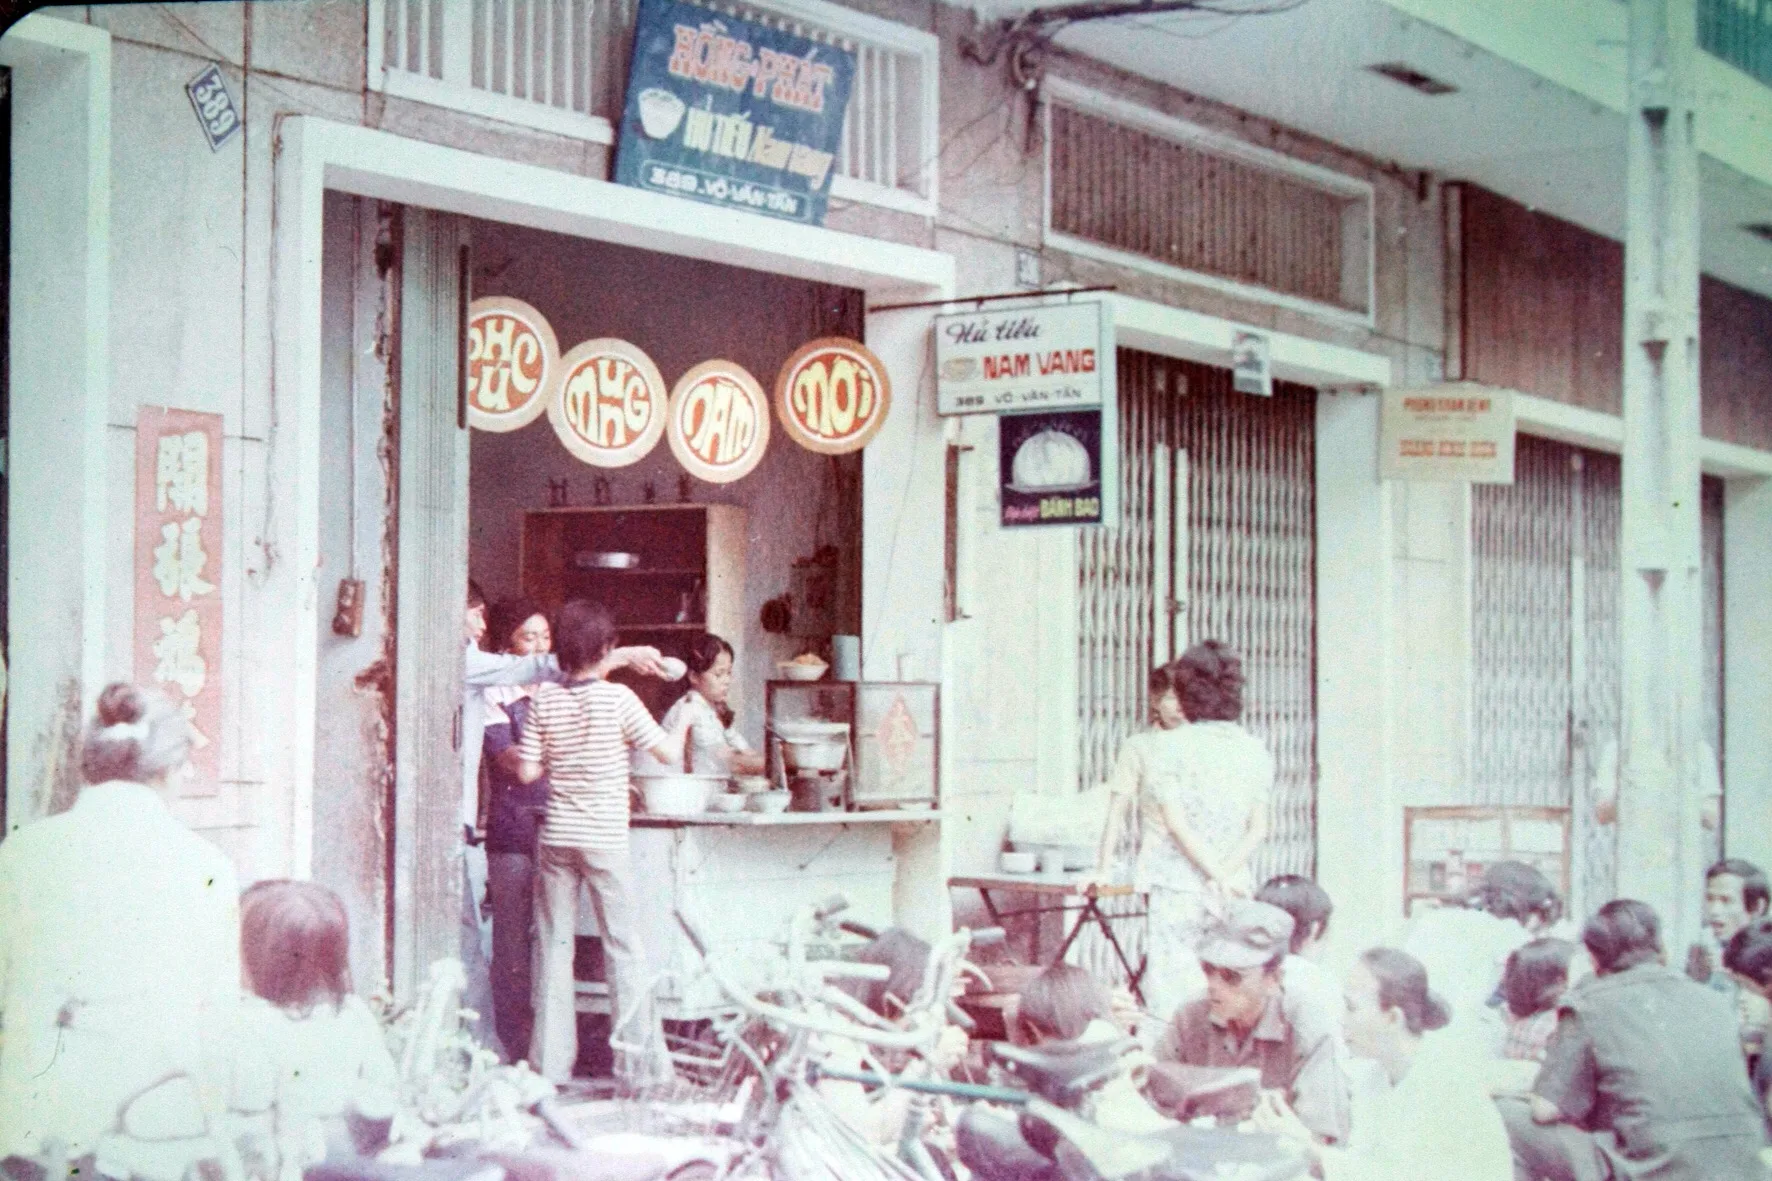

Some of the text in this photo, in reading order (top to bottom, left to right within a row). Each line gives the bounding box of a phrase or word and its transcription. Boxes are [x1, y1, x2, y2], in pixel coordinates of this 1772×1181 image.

[195, 74, 235, 135] 389
[946, 318, 988, 343] Hủ
[983, 348, 1095, 379] NAM VANG
